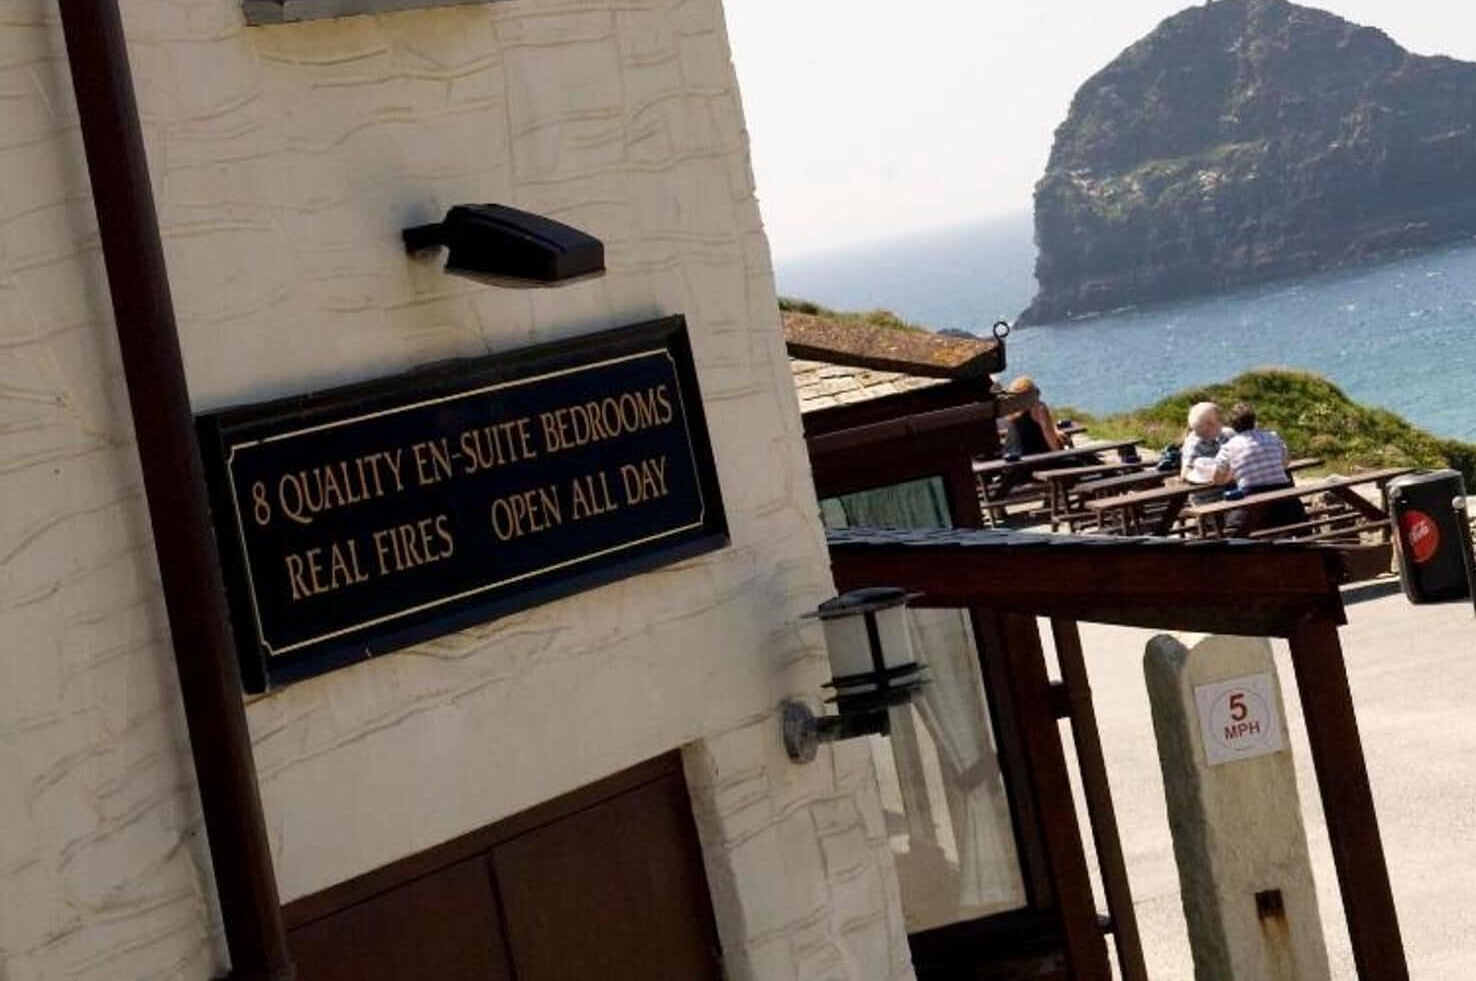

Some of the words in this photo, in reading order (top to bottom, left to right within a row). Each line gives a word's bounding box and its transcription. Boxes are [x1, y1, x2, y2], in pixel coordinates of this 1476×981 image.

[252, 480, 272, 526] 8
[278, 448, 405, 525] QUALITY
[412, 418, 537, 486] EN-SUITE
[540, 384, 673, 453] BEDROOMS
[285, 539, 369, 602] REAL
[372, 514, 455, 576] FIRES
[490, 484, 563, 542] OPEN
[572, 471, 618, 520] ALL
[620, 455, 670, 505] DAY
[1224, 720, 1261, 740] MPH
[1229, 693, 1249, 722] 5
